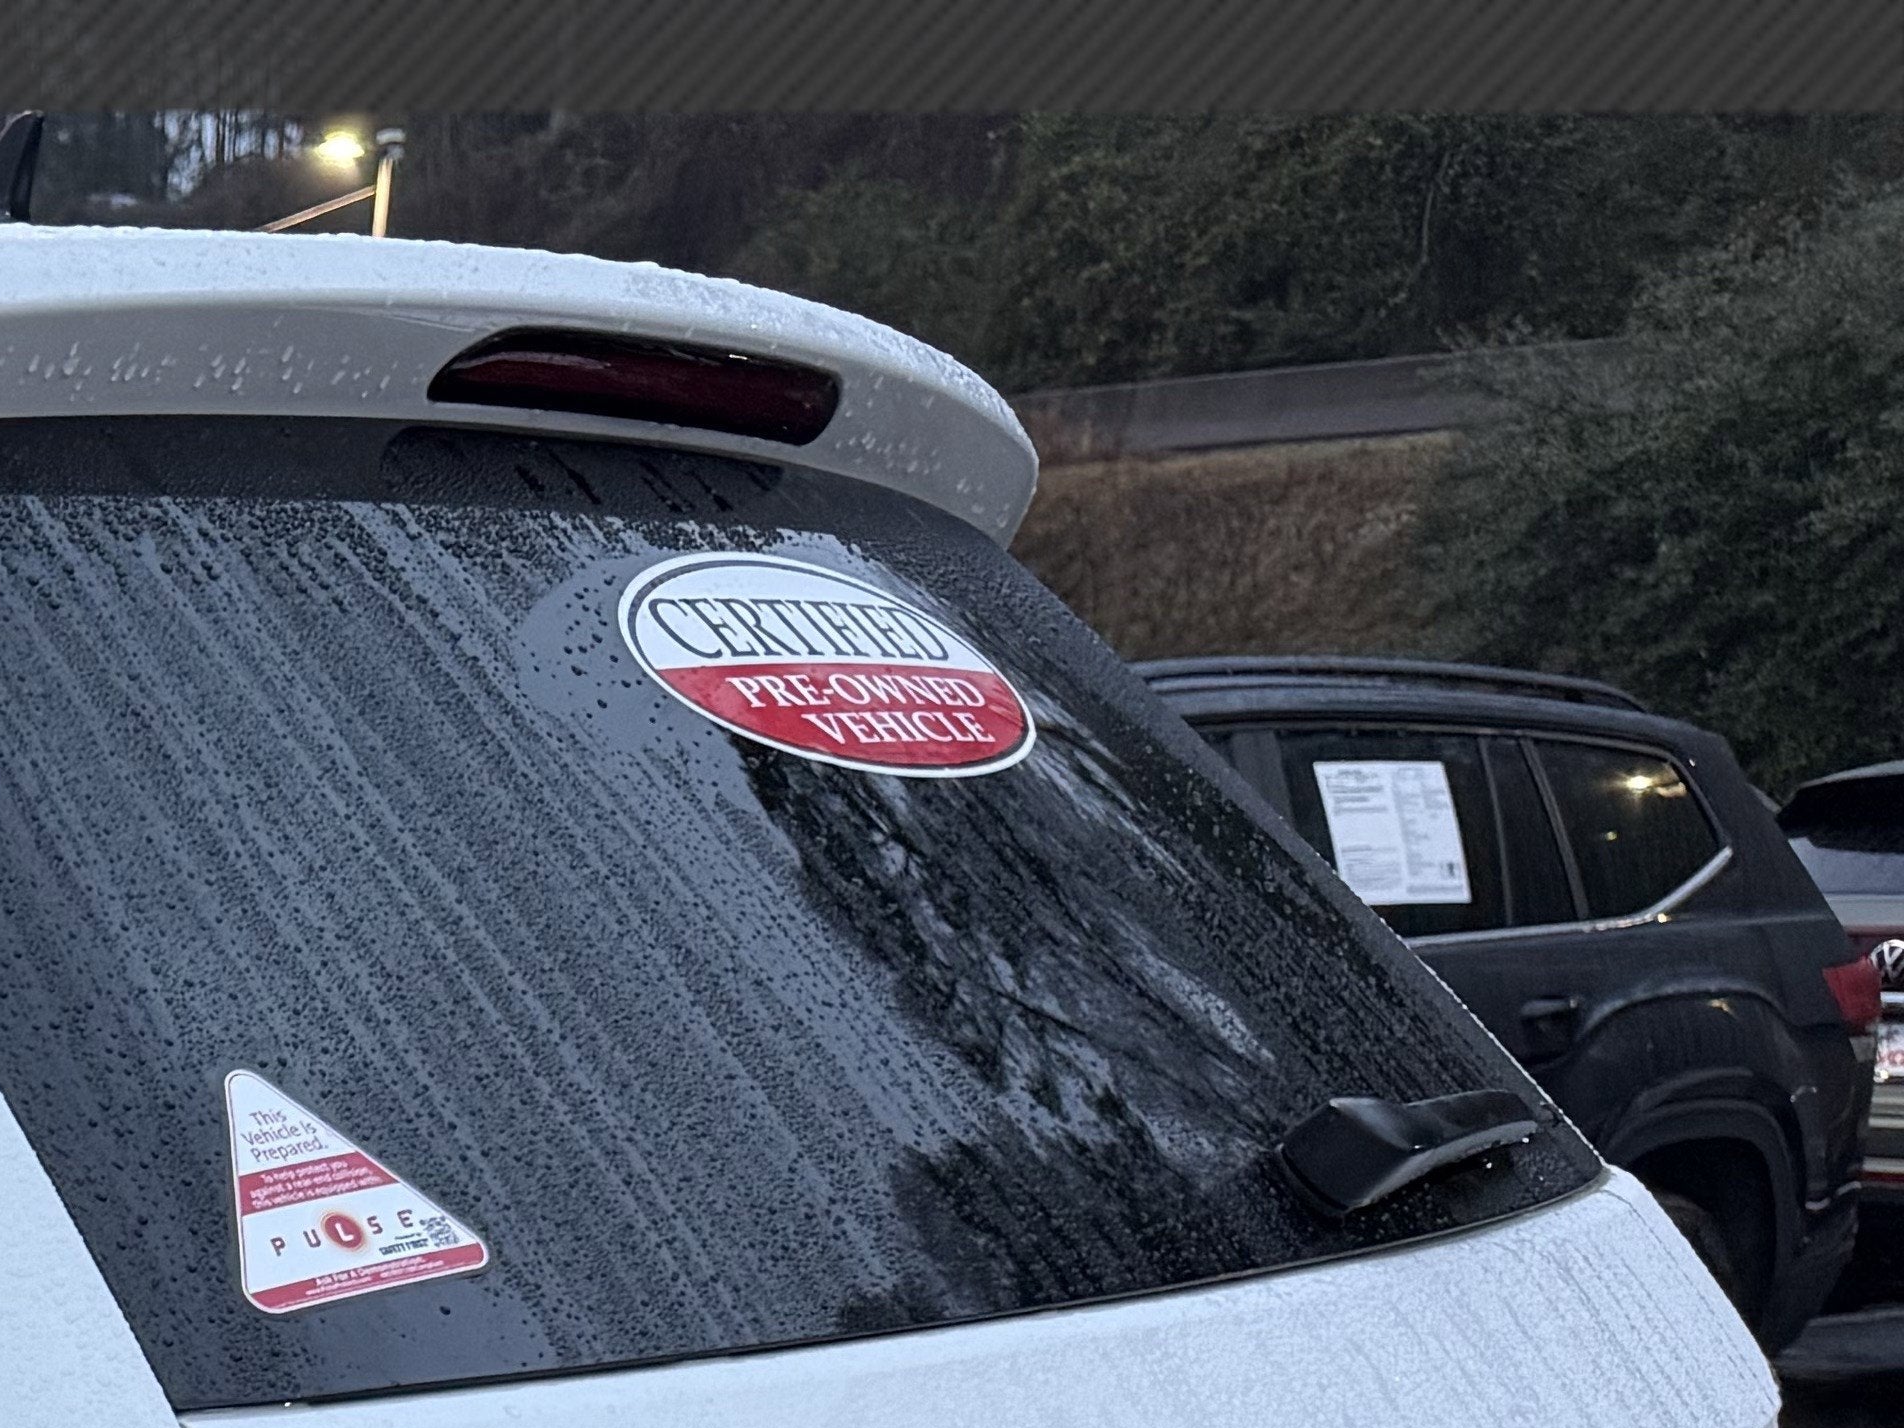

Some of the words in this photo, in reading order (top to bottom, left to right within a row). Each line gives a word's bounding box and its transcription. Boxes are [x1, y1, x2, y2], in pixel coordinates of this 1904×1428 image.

[649, 597, 950, 660] CERTIFIED
[726, 672, 986, 709] PRE-OWNED
[801, 711, 996, 744] VEHICLE
[250, 1108, 287, 1126] This
[241, 1126, 301, 1147] Vehicle
[251, 1138, 329, 1163] Prepared.
[270, 1208, 414, 1258] PULSE
